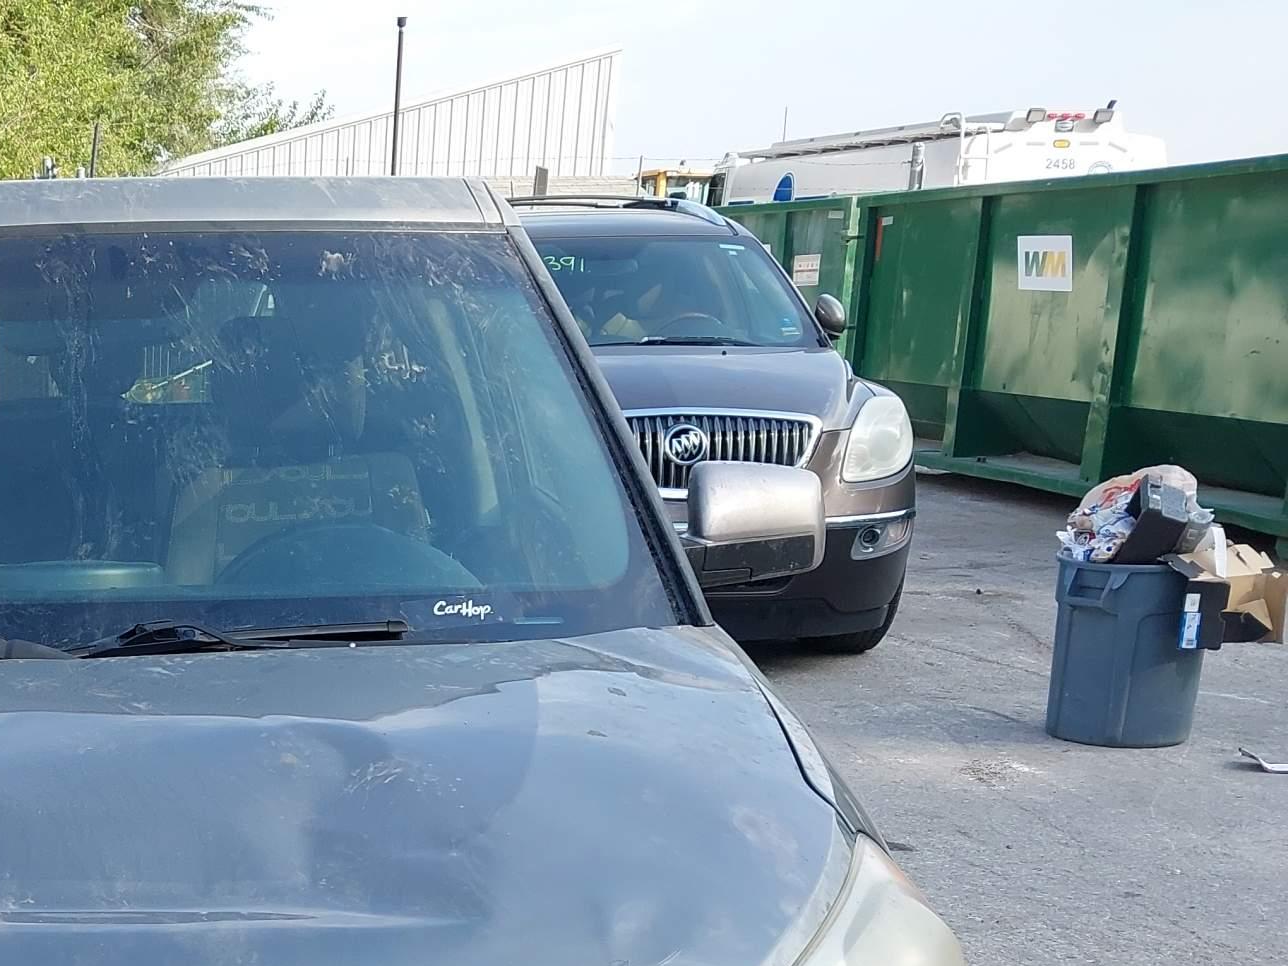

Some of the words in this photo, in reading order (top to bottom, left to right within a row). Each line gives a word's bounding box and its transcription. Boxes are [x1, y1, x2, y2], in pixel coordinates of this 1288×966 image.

[1045, 158, 1076, 170] 2458
[543, 255, 585, 273] 391
[1024, 250, 1066, 278] WM
[433, 600, 492, 620] CarHop
